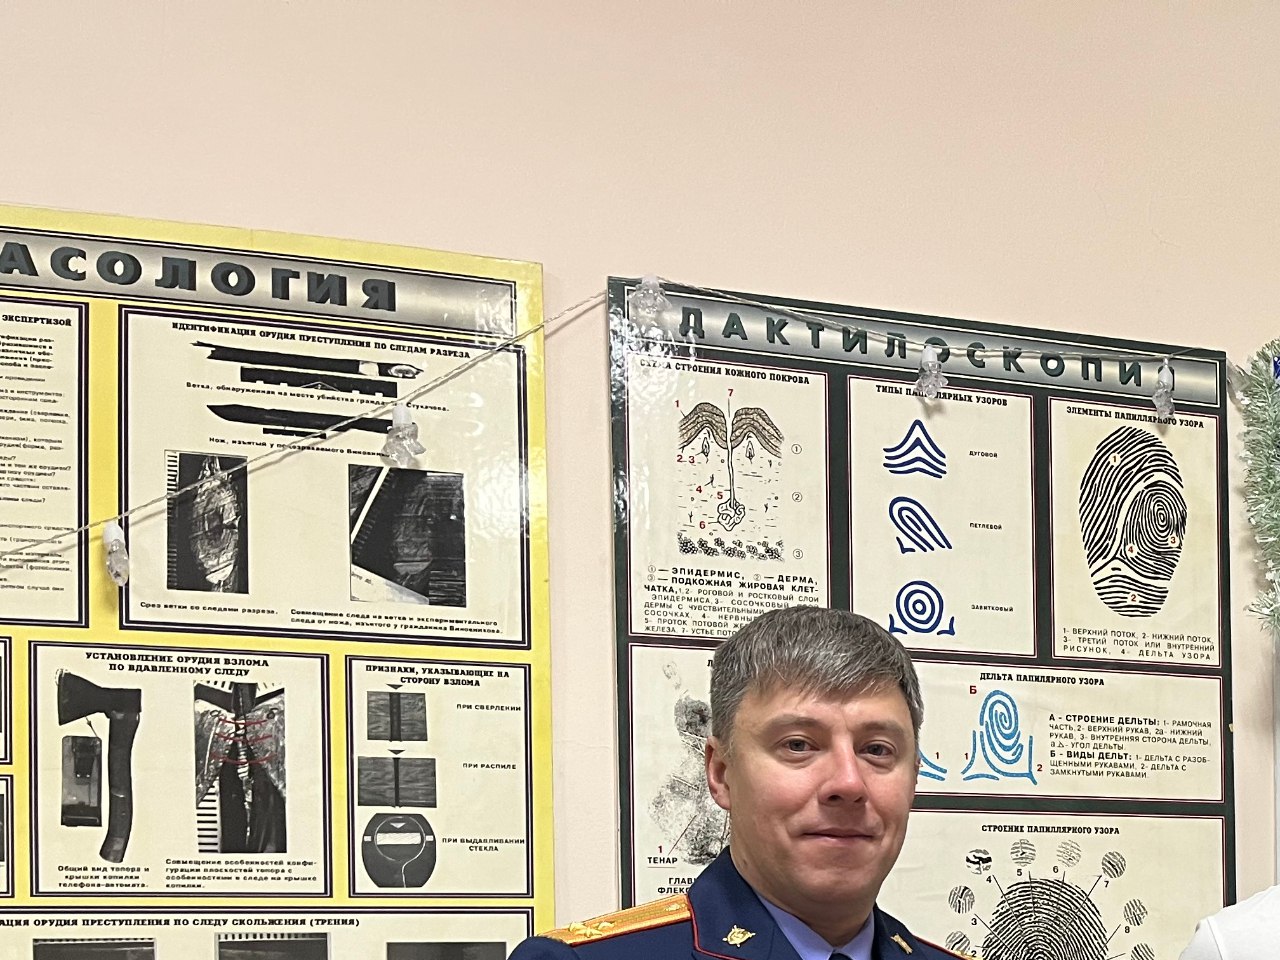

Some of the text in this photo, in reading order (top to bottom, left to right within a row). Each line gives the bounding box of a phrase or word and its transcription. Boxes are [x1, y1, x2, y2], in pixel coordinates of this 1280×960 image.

[0, 241, 397, 312] АСОЛОГИЯ
[1, 314, 71, 326] ЭКСПЕРТИЗОЙ
[171, 321, 473, 361] ИДЕНТИФИКАЦИЯ ОРУДИЯ ПРЕСТУПЛЕНИЯ ПО СЛЕДАМ РАЗРЕЗА
[675, 364, 721, 374] СТРОЕНИЯ
[725, 368, 766, 379] КОЖНОГО
[770, 373, 809, 384] ПОКРОВА
[875, 384, 1007, 406] ТИПЫ УЗОРОВ
[1066, 406, 1112, 418] ЭЛЕМЕНТЫ
[1178, 418, 1204, 428] УЗОРА
[968, 450, 997, 458] ДУГОВОЙ
[969, 521, 1002, 530] ПЕТЛЕВОЙ
[672, 568, 745, 580] ЭПИДЕРМИС,
[778, 575, 818, 586] ДЕРМА,
[671, 576, 818, 593] ПОДКОЖНАЯ ЖИРОВАЯ КЛЕТ-
[1063, 626, 1213, 645] 1- ВЕРХНИЙ ПОТОК, 2- НИЖНИЙ ПОТОК,
[1063, 644, 1111, 654] РИСУНОК,
[1138, 649, 1173, 658] ДЕЛЬТА
[1181, 652, 1210, 660] УЗОРА
[85, 651, 269, 667] УСТАНОВЛЕНИЕ ОРУДИЯ ВЗЛОМА
[108, 662, 250, 677] ПО ВДАВЛЕННОМУ СЛЕДУ
[365, 664, 509, 678] ПРИЗНАКИ, УКАЗЫВАЮЩИЕ НА
[400, 677, 480, 686] СТОРОНУ ВЗЛОМА
[979, 672, 1104, 685] ДЕЛЬТА ПАПИЛЯРНОГО УЗОРА
[1049, 713, 1055, 721] А
[1065, 714, 1114, 723] СТРОЕНИЕ
[1117, 716, 1159, 726] ДЕЛЬТЫ:
[480, 762, 516, 770] РАСПИЛЕ
[981, 824, 1119, 834] СТРОЕНИЕ ПАПИЛЛЯРНОГО УЗОРА
[647, 856, 677, 864] ТЕНАР
[1016, 869, 1022, 877] 5
[1104, 880, 1109, 888] 7
[33, 918, 77, 927] ОРУДИЯ
[81, 918, 170, 926] ПРЕСТУПЛЕНИЯ
[173, 918, 189, 926] ПО
[192, 918, 228, 926] СЛЕДУ
[231, 918, 306, 926] СКОЛЬЖЕНИЯ
[309, 918, 359, 927] (ТРЕНИЯ)
